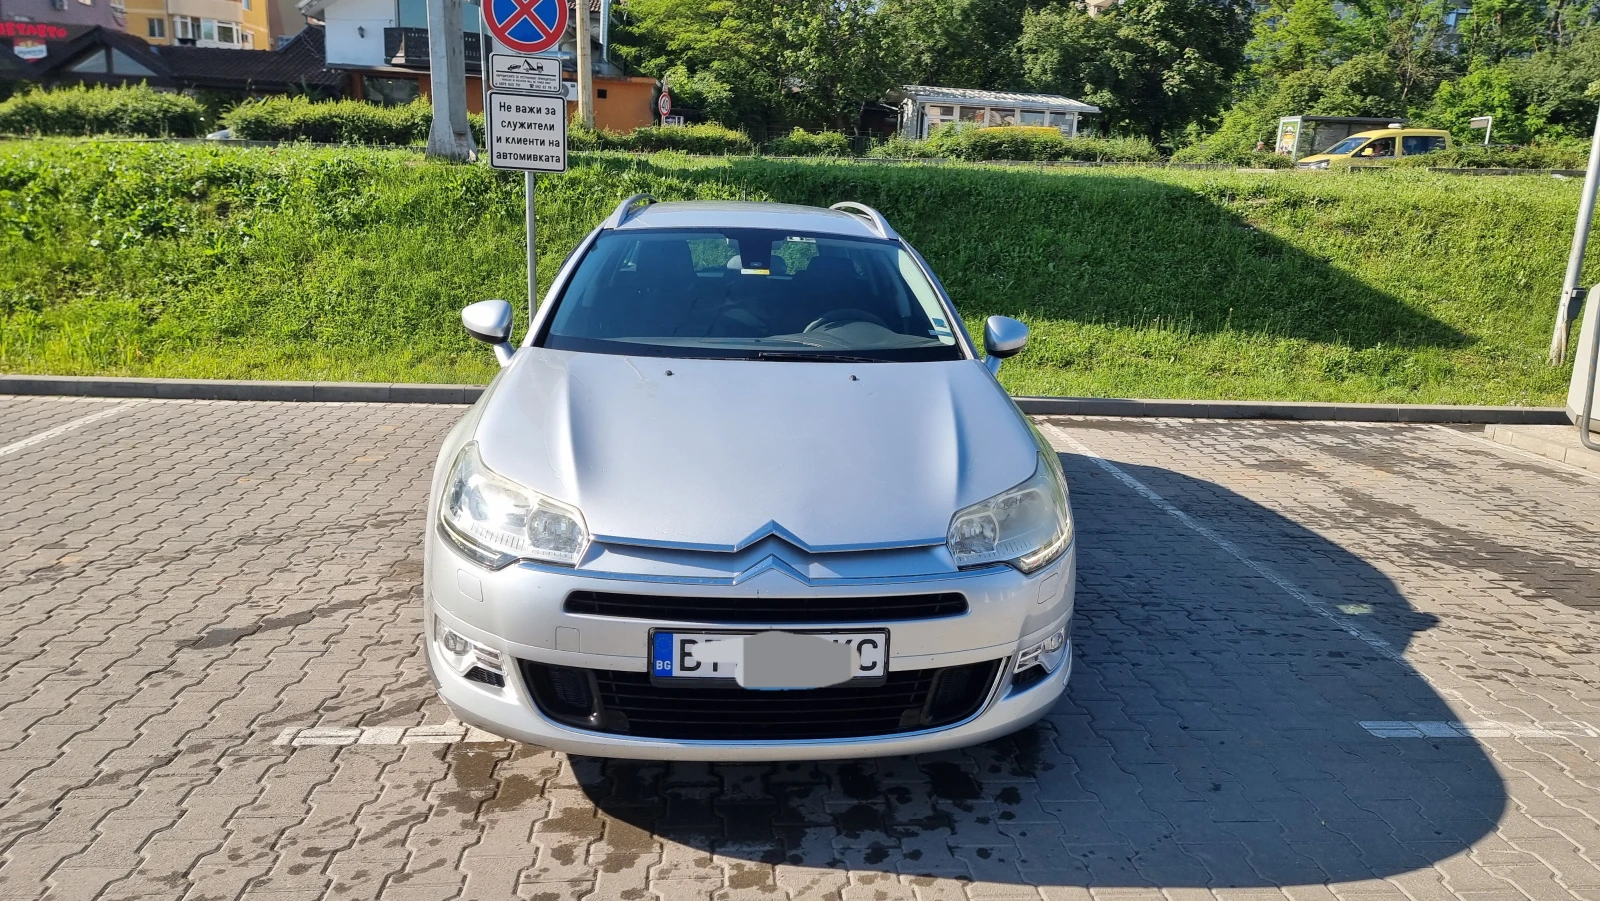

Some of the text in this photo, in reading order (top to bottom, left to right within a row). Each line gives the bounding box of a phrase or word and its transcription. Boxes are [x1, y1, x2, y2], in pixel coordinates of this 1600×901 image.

[499, 101, 556, 116] Не важи за
[501, 120, 555, 131] служители
[496, 135, 560, 148] и клиенти на
[496, 151, 561, 163] автомивката
[655, 660, 672, 670] BG
